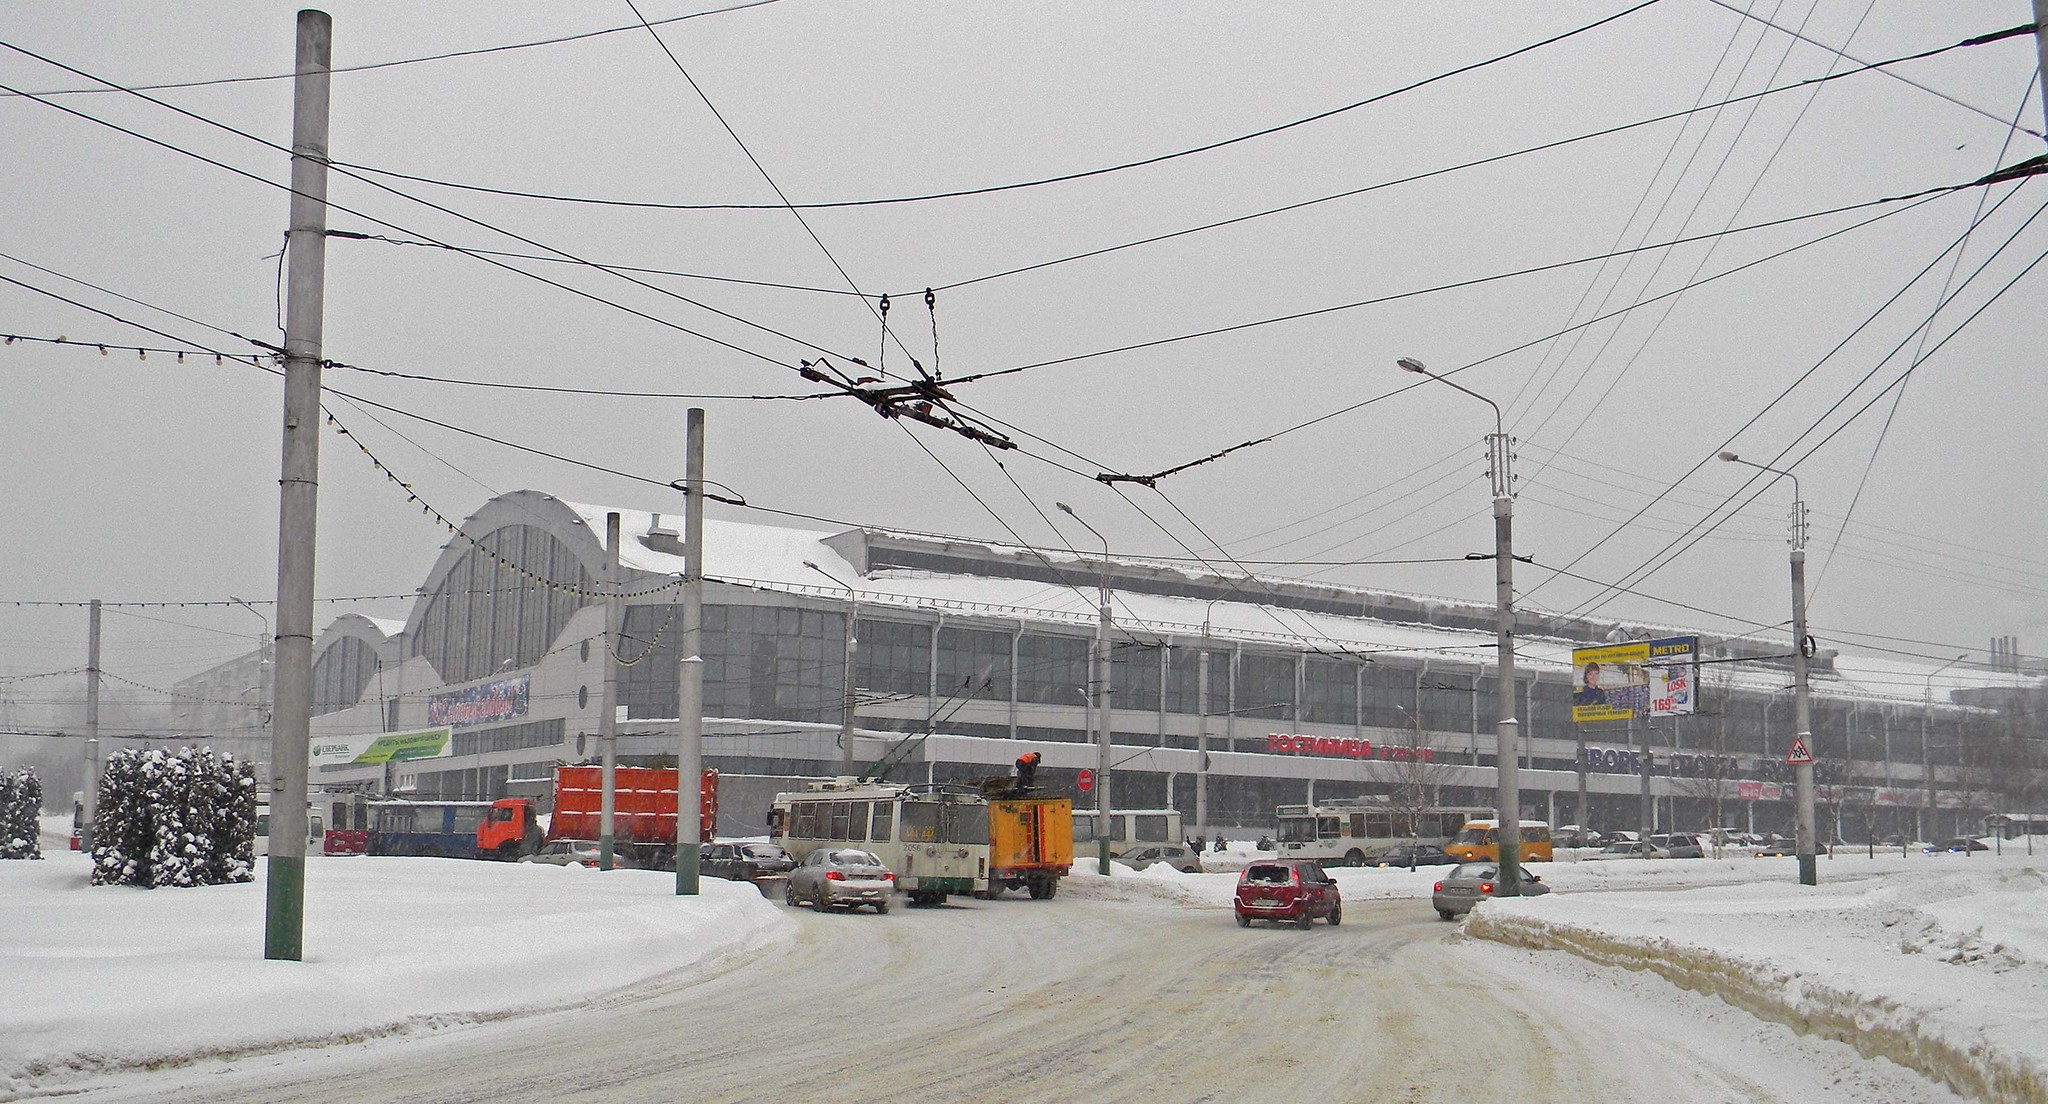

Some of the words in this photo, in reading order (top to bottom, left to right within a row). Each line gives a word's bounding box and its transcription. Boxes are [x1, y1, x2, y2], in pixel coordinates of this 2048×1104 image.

[1653, 644, 1689, 656] METRO
[1667, 679, 1687, 692] LOSK
[1652, 698, 1671, 711] 169
[322, 744, 350, 753] СБЕРБАНК
[1267, 734, 1373, 759] ГОСТИНИЦА
